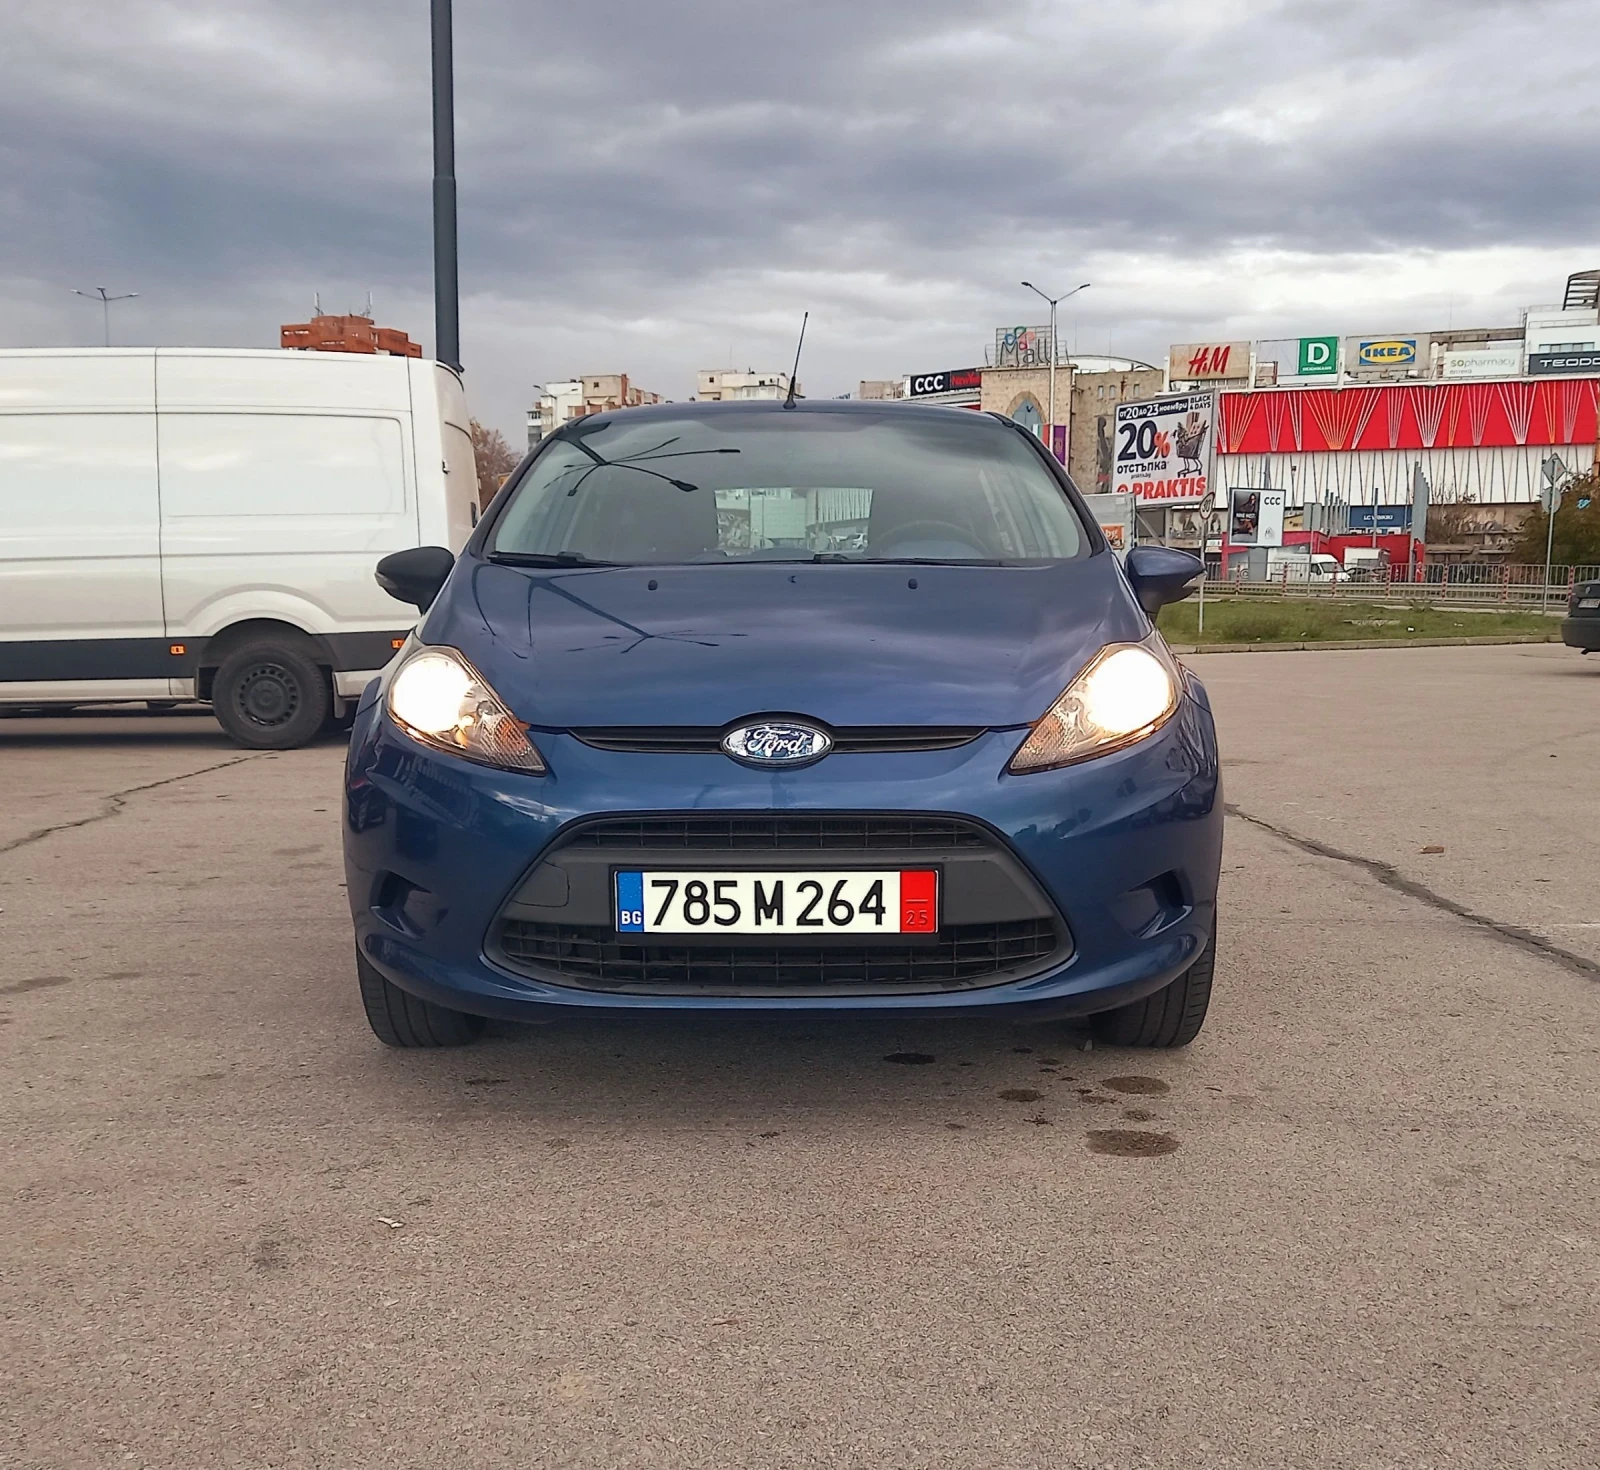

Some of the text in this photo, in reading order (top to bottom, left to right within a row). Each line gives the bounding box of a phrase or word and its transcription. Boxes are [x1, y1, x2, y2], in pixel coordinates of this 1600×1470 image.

[1000, 338, 1051, 367] Mall
[1188, 345, 1231, 376] H&M
[1307, 342, 1330, 365] D
[1365, 346, 1414, 358] IKEA
[1450, 357, 1516, 368] sopharmacy
[914, 375, 944, 393] CCC
[1190, 395, 1212, 404] BLACK
[1195, 401, 1212, 410] DAYS
[1126, 407, 1139, 420] 20
[1147, 403, 1160, 417] 23
[1118, 420, 1170, 461] 20%
[1132, 477, 1207, 500] PRAKTIS
[1264, 496, 1281, 506] CCC
[747, 724, 804, 757] Ford
[621, 879, 886, 927] BG 785 M 264
[905, 909, 929, 926] 25
